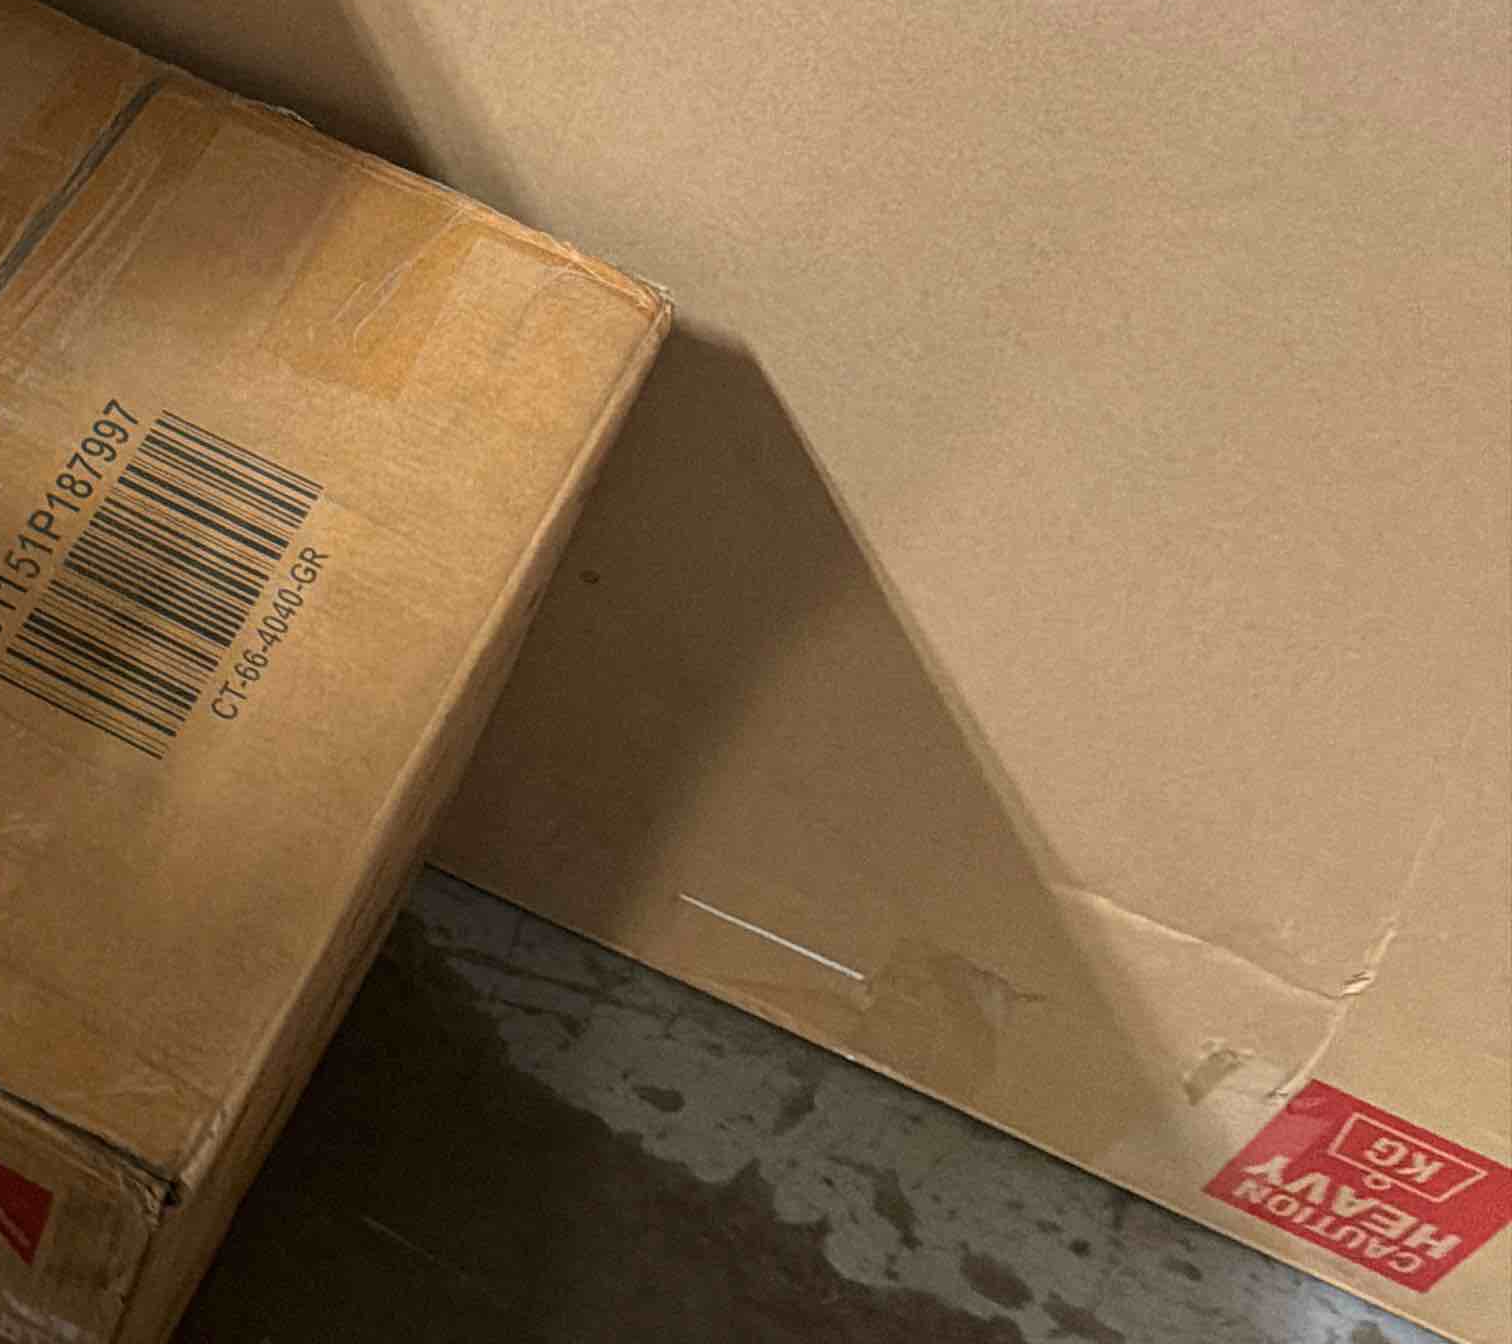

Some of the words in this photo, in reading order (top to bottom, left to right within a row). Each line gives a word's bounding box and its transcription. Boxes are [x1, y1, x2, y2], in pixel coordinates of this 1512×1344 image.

[211, 546, 330, 721] CT-66-4040-GR
[1243, 1154, 1463, 1261] HEAVY
[1365, 1136, 1446, 1185] KG
[1232, 1178, 1425, 1274] CAUTION
